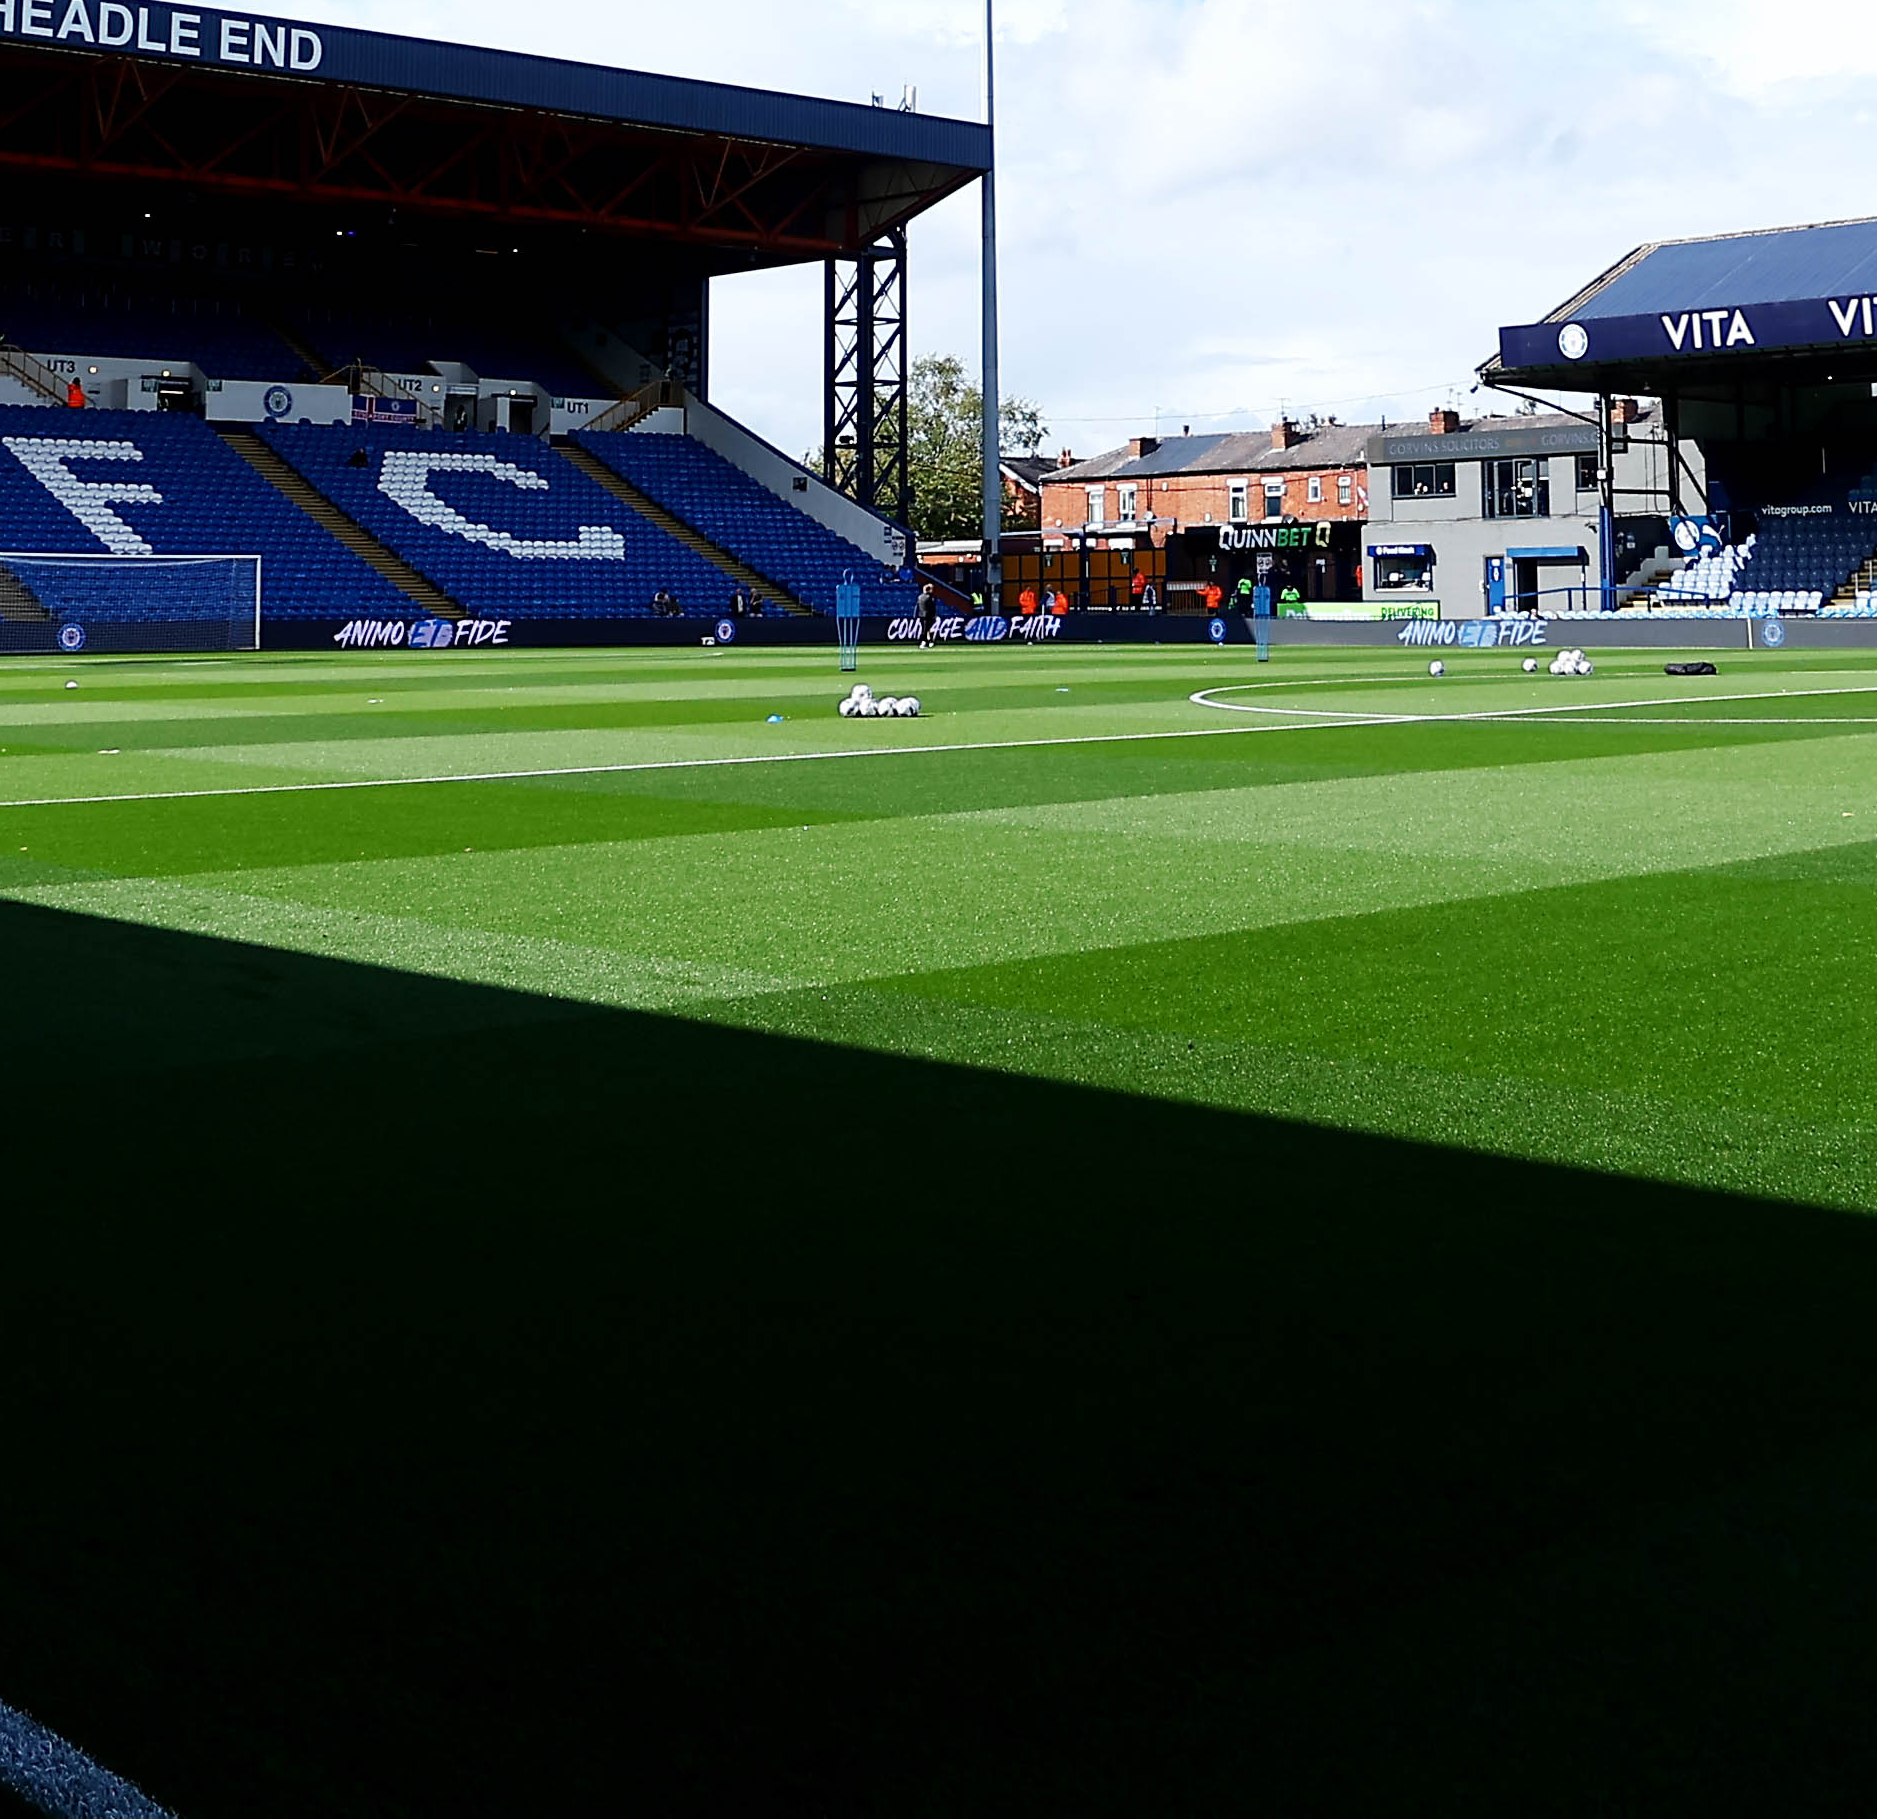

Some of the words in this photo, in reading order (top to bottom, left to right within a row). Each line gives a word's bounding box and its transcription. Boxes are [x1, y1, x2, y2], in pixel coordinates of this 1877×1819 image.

[220, 18, 322, 71] END
[1661, 309, 1756, 351] VITA
[47, 359, 76, 373] UT3
[398, 379, 422, 392] UT2
[567, 400, 589, 414] UT1
[1388, 441, 1439, 455] GORVINS
[1441, 437, 1500, 453] SOLICITORS
[1, 436, 164, 556] F
[377, 450, 627, 561] C
[1761, 502, 1832, 517] vitagroup.com
[1218, 524, 1312, 551] QUINNBET
[333, 619, 405, 649] ANIMO
[454, 619, 512, 646] FIDE
[887, 616, 964, 642] COUAGE
[965, 616, 1007, 641] AND
[1008, 615, 1061, 639] FAITH
[1397, 620, 1456, 647] ANIMO
[1497, 620, 1548, 646] FIDE
